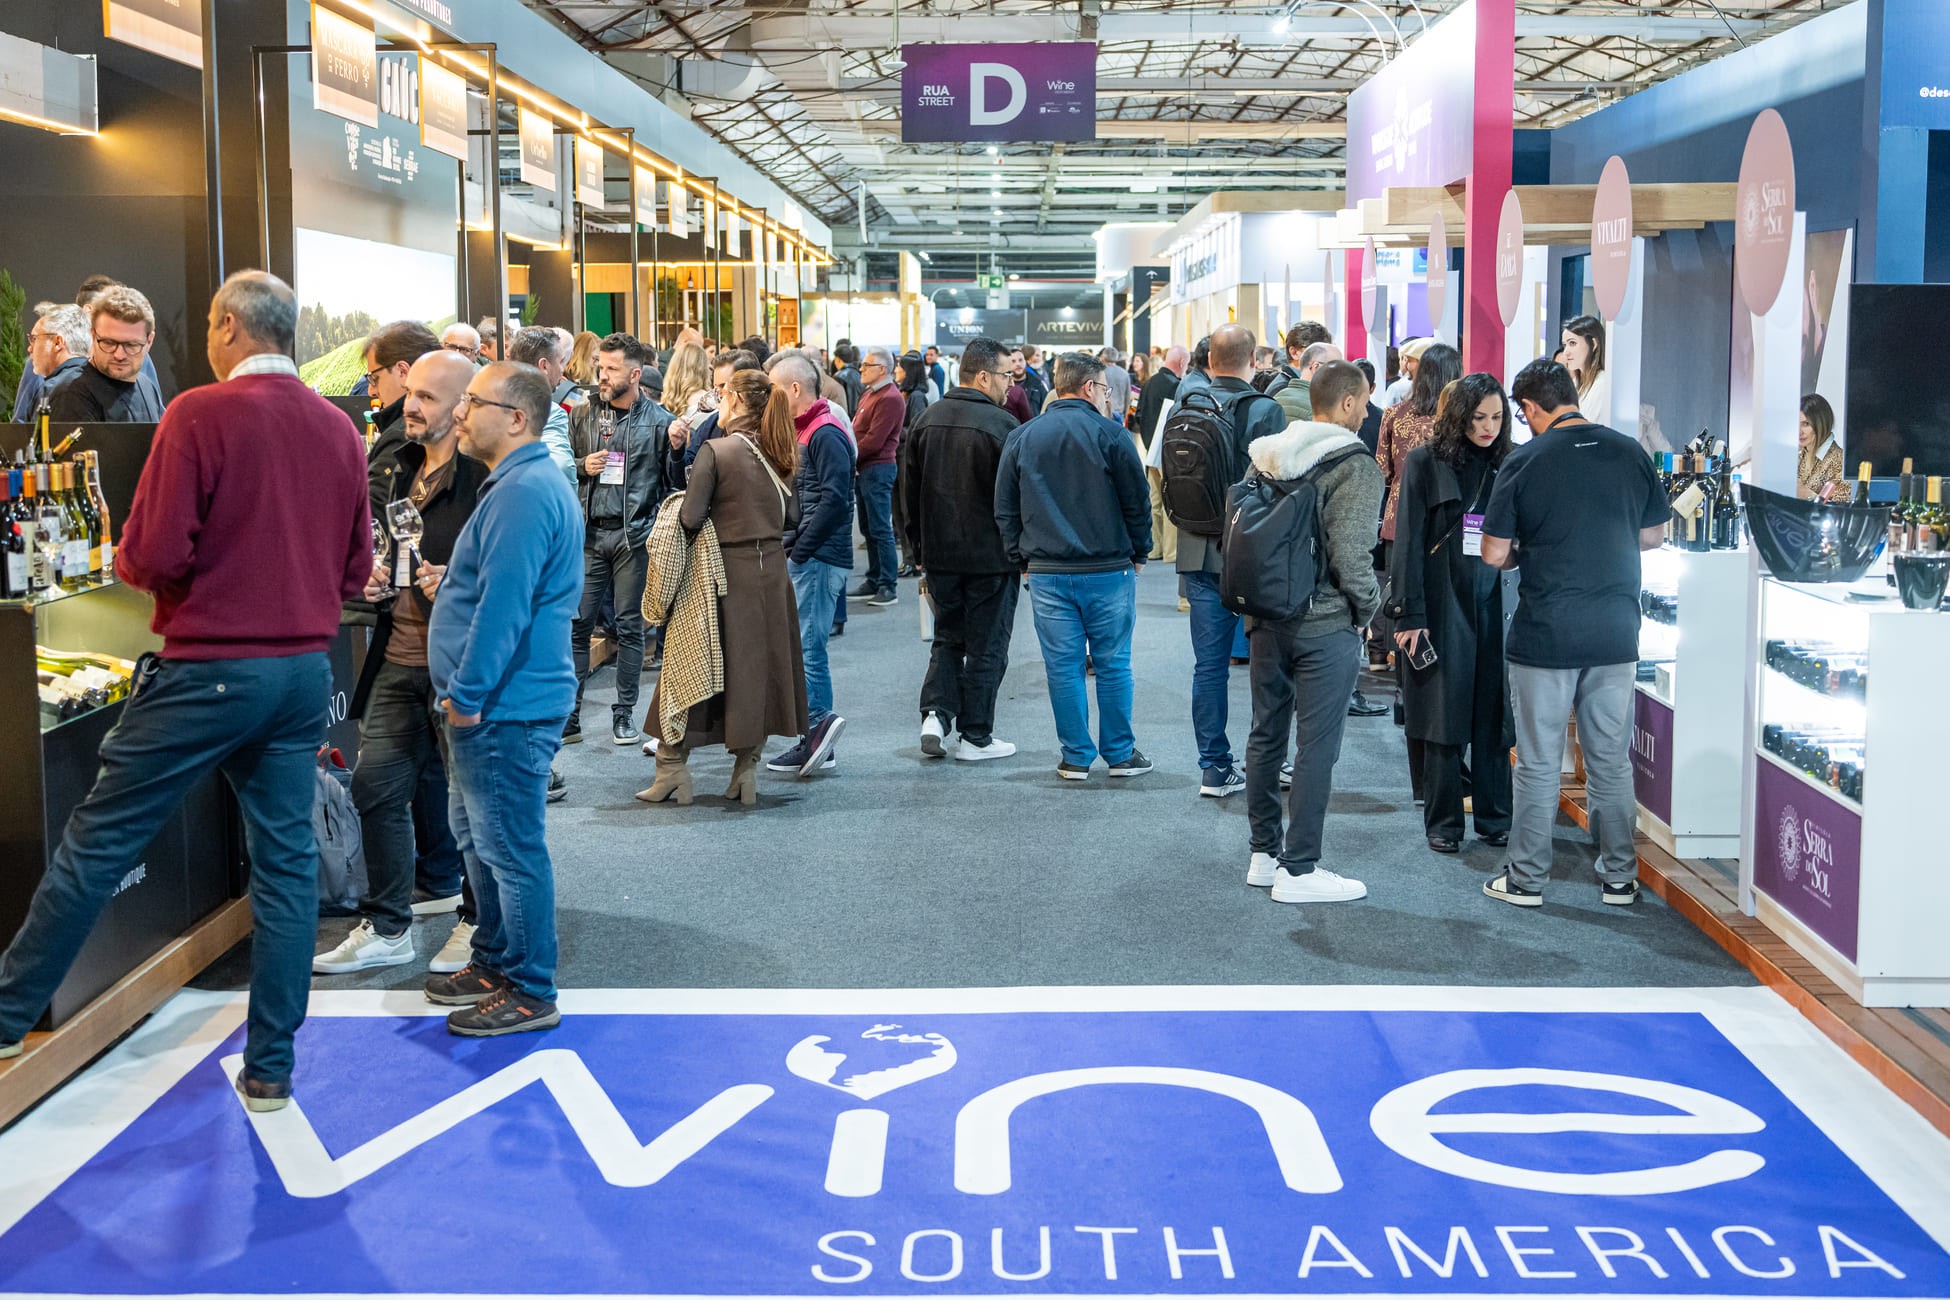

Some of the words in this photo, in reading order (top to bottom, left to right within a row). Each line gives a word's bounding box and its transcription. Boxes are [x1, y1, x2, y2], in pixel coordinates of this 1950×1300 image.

[334, 56, 359, 83] FERRO
[923, 85, 950, 96] RUA
[970, 63, 1027, 126] D
[1046, 80, 1075, 90] Wine
[1920, 87, 1950, 98] @des
[918, 96, 955, 106] STREET
[1597, 217, 1627, 245] VIVALTI
[1803, 818, 1833, 867] SERRA
[120, 862, 146, 892] BOUTIQUE
[1811, 855, 1831, 898] SOL
[811, 1225, 1236, 1284] SOUTH
[1297, 1224, 1907, 1280] AMERICA
